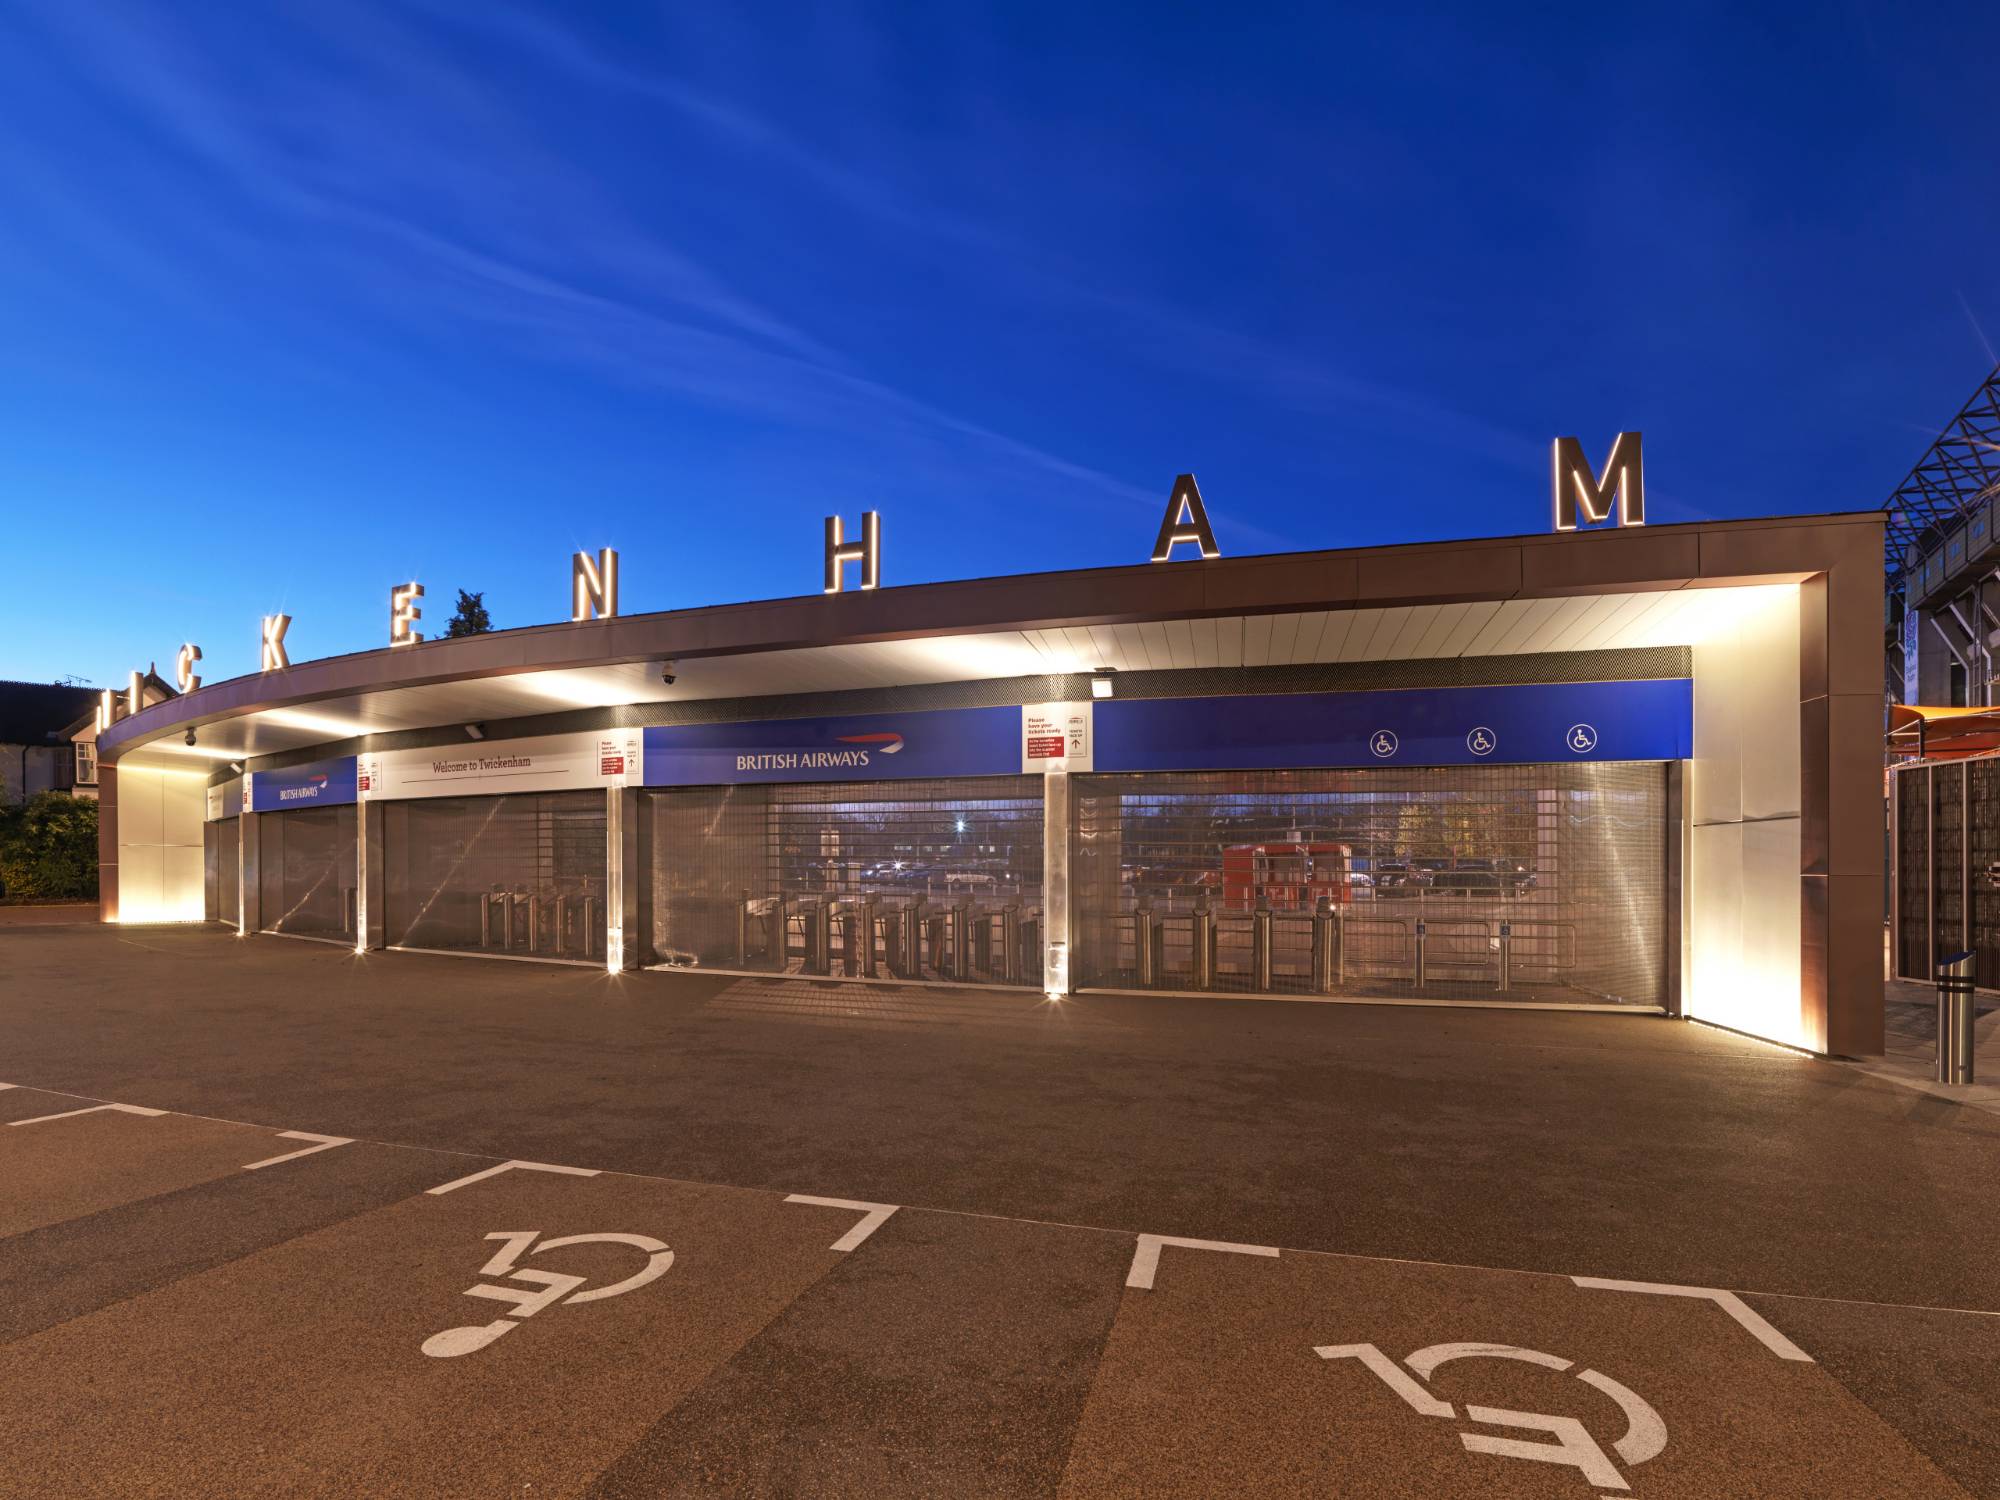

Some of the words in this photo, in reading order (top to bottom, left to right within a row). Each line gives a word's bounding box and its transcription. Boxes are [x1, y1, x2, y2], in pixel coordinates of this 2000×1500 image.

[432, 760, 468, 774] Welcome
[468, 761, 478, 771] to
[478, 754, 531, 770] Twickenham
[736, 753, 797, 771] BRITISH
[800, 750, 870, 768] AIRWAYS
[280, 788, 298, 801] BRITISH
[297, 785, 318, 799] AIRWAYS
